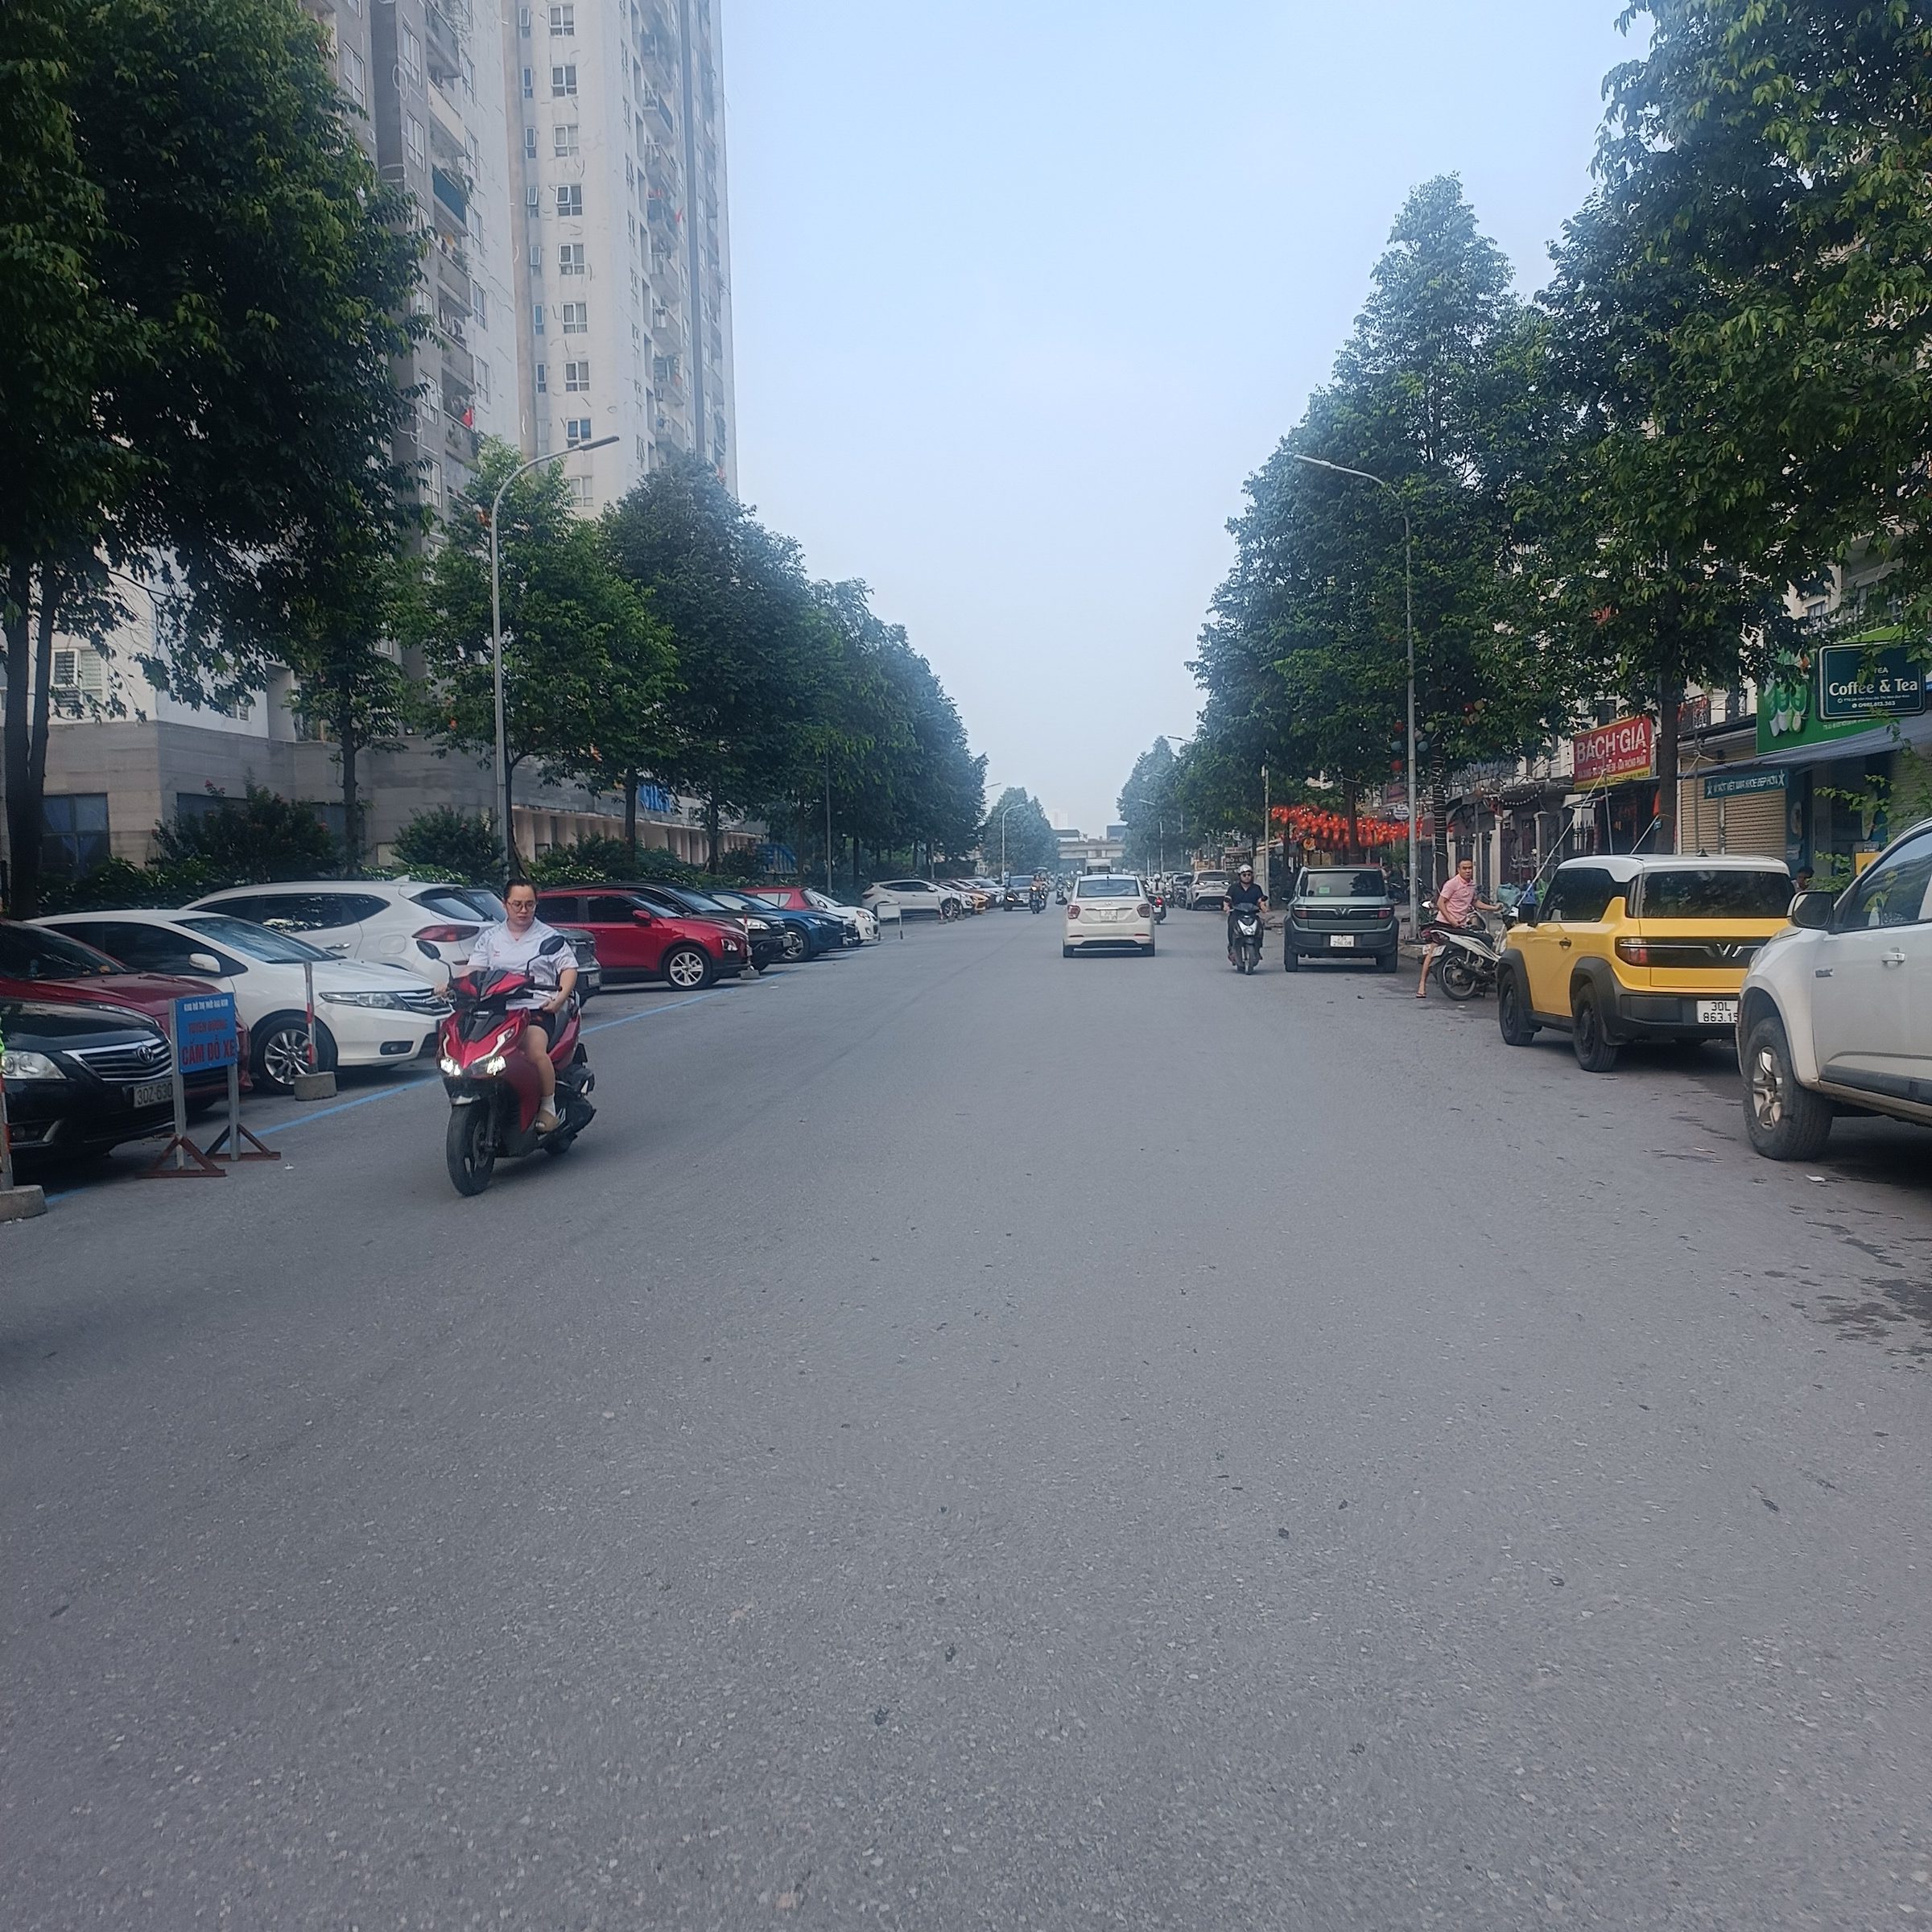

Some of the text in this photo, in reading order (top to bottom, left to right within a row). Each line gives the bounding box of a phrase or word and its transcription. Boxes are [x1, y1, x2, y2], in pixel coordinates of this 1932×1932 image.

[1829, 681, 1875, 696] Coffee
[1880, 679, 1891, 692] &
[1894, 678, 1918, 691] Tea
[1577, 722, 1647, 764] BÁCH GIA
[1711, 1001, 1731, 1011] 30L
[1703, 1012, 1739, 1022] 863.15
[223, 1038, 235, 1058] XE
